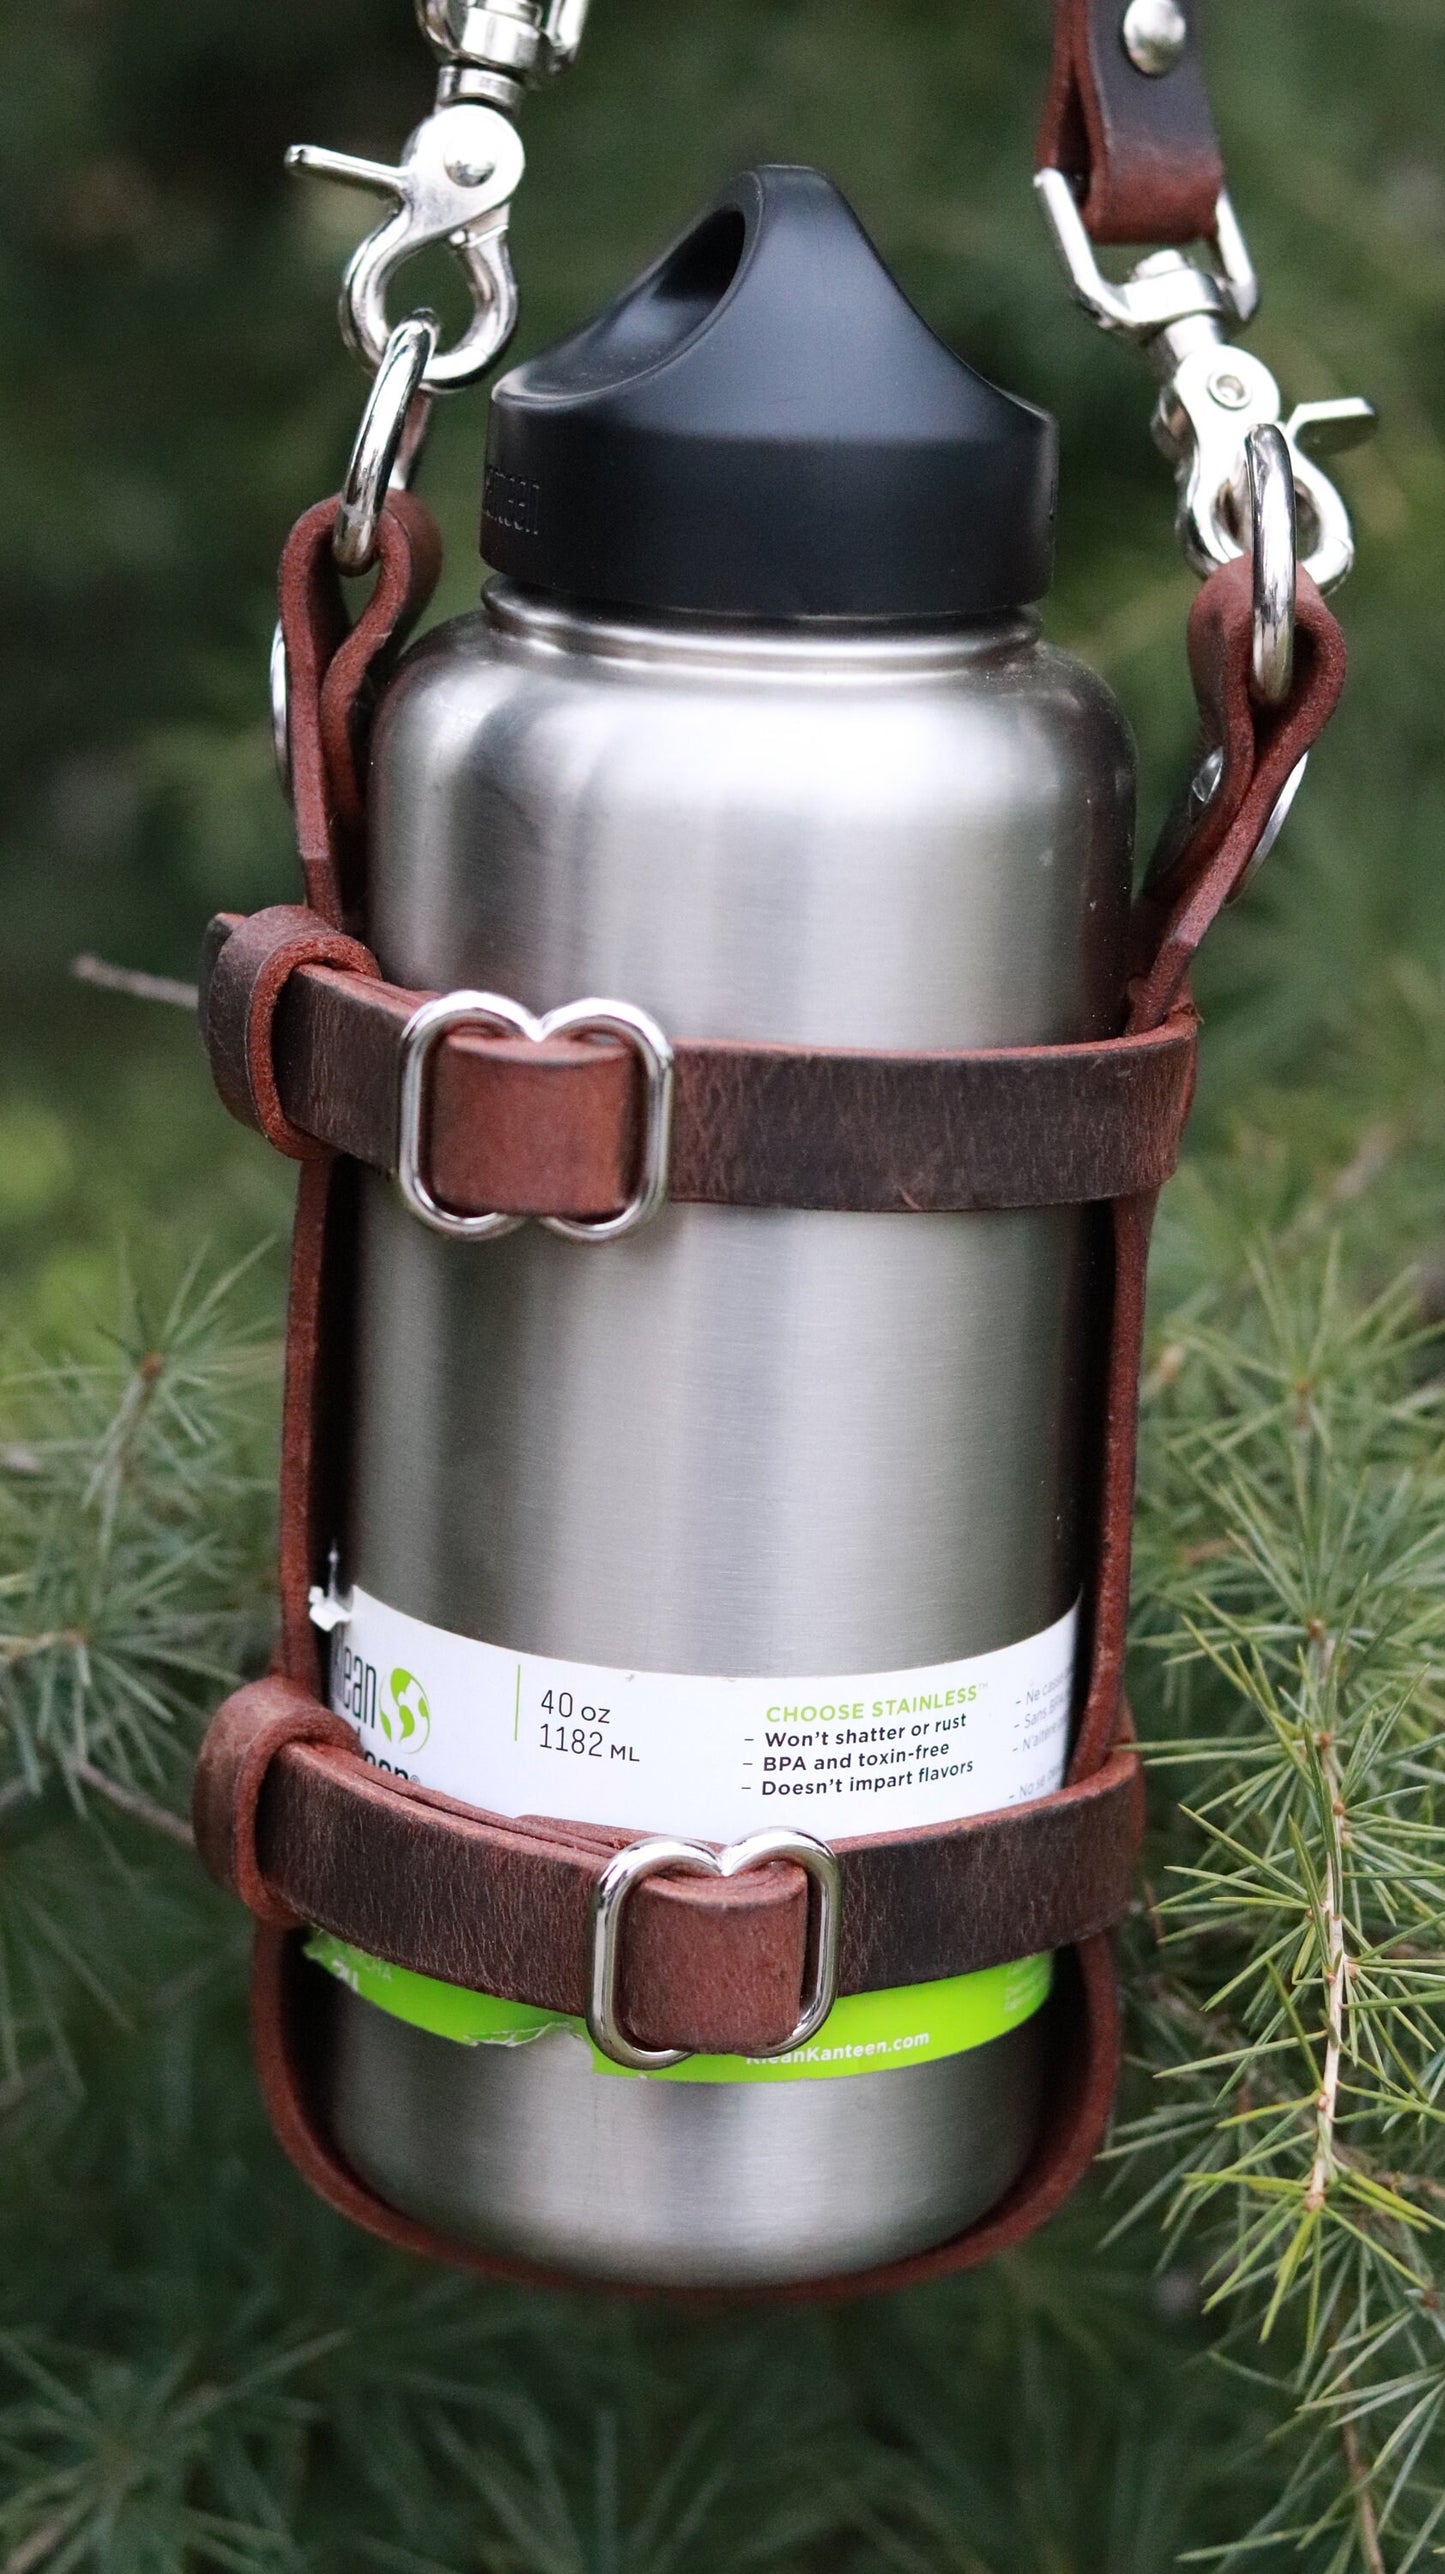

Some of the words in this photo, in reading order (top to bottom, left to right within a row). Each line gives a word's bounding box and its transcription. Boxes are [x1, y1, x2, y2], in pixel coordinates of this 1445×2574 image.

[541, 1690, 573, 1718] 40
[581, 1706, 611, 1724] oz
[766, 1703, 865, 1723] CHOOSE
[540, 1723, 603, 1757] 1182
[611, 1744, 640, 1762] ML
[765, 1731, 829, 1748] Won't
[835, 1727, 905, 1745] shatter
[911, 1723, 930, 1737] or
[935, 1713, 967, 1733] rust
[763, 1756, 807, 1772] BPA
[814, 1753, 852, 1770] and
[858, 1743, 949, 1767] toxin-free
[762, 1779, 842, 1796] Doesn't
[850, 1771, 912, 1793] impart
[918, 1761, 973, 1783] flavors
